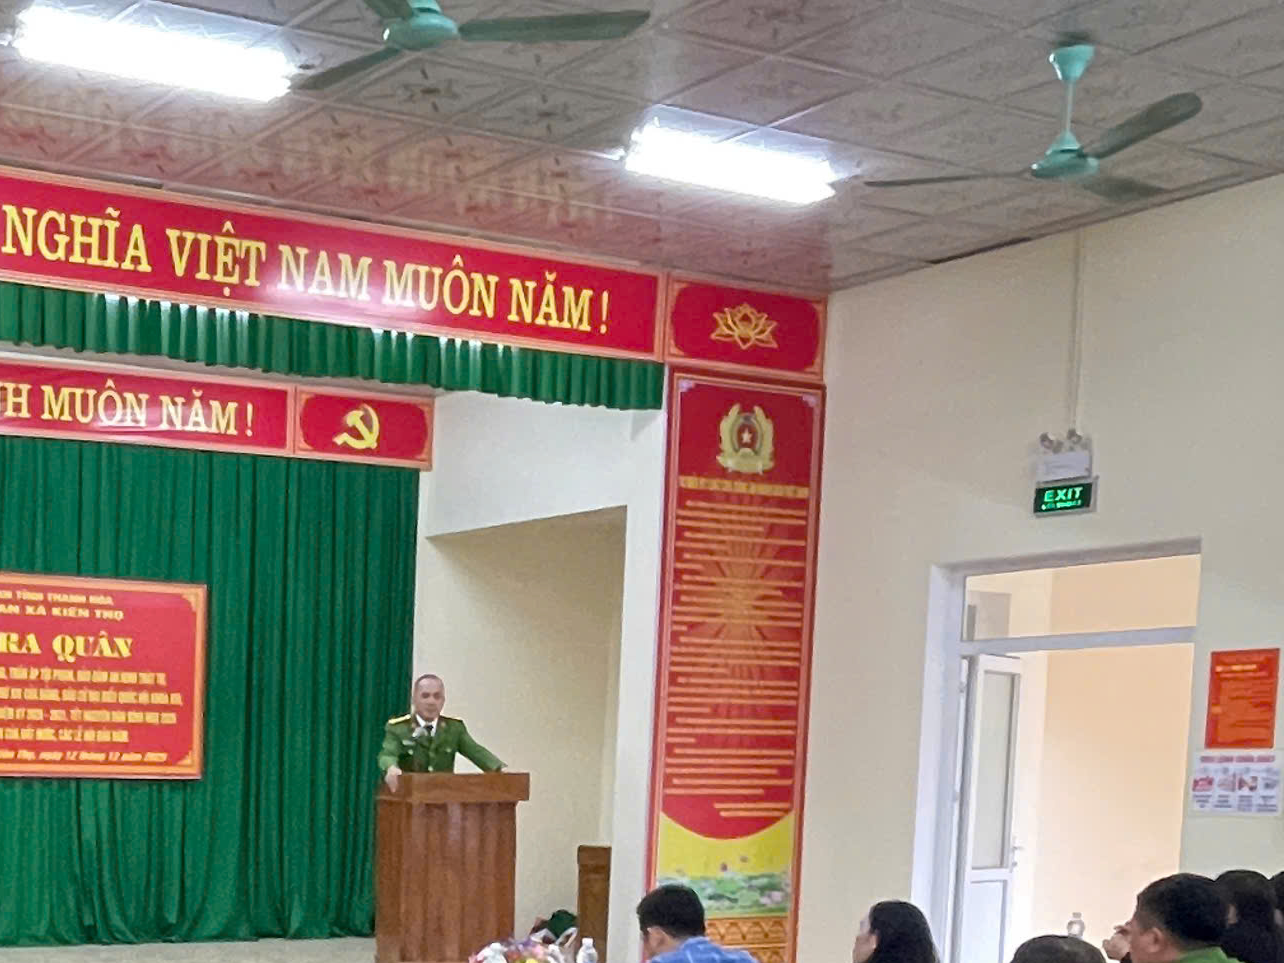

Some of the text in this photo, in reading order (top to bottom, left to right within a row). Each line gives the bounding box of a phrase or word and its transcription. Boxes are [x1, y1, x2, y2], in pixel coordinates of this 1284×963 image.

[1, 206, 152, 273] NGHĨA
[166, 221, 266, 297] VIỆT
[276, 244, 373, 302] NAM
[382, 254, 500, 319] MUÔN
[41, 378, 150, 428] MUÔN
[1044, 486, 1083, 502] EXIT
[52, 630, 133, 663] QUÂN
